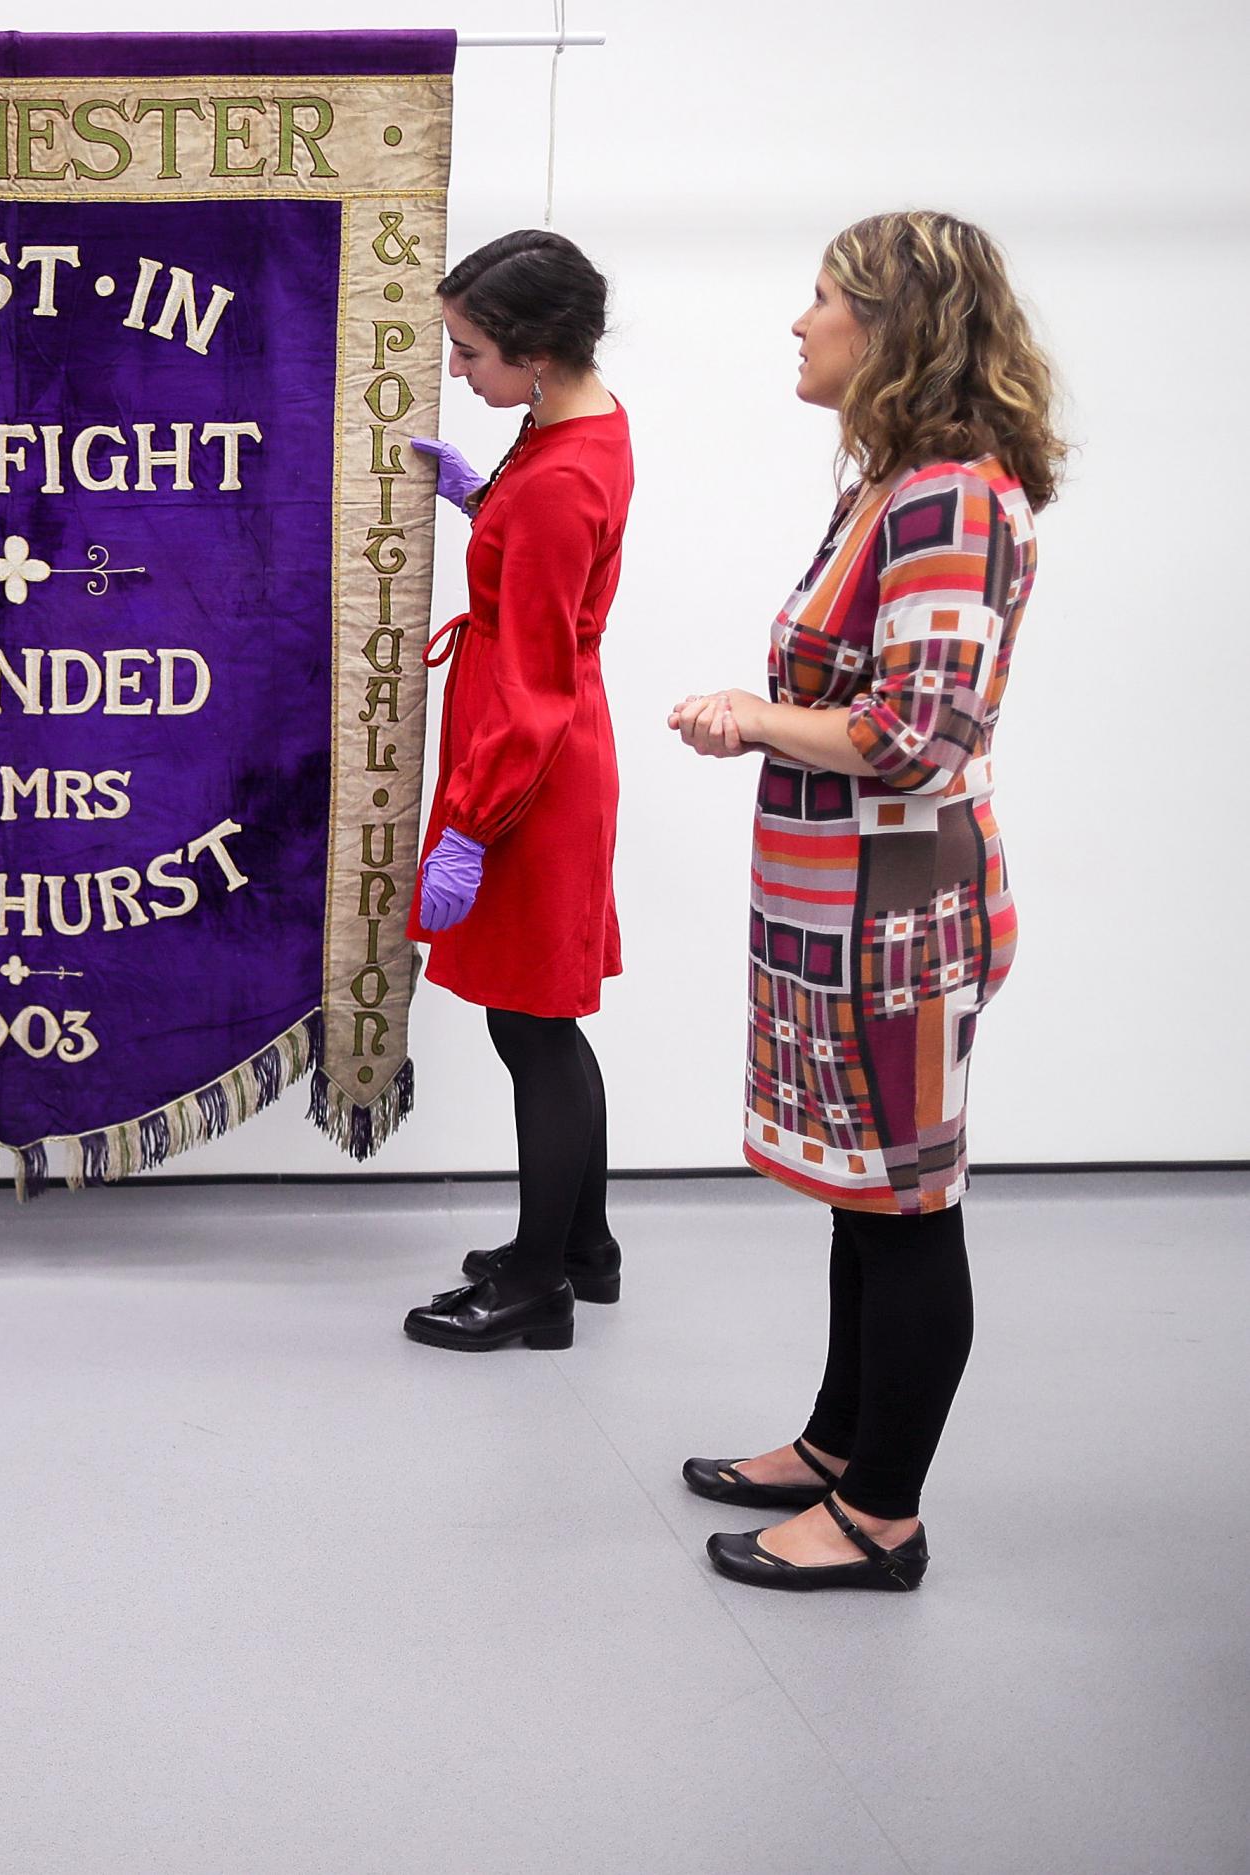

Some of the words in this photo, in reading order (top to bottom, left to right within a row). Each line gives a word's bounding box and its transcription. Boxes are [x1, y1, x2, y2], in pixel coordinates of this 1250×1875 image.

[121, 256, 235, 356] IN
[372, 210, 421, 266] &
[359, 320, 416, 772] POLITICAL
[350, 823, 397, 1057] UNION
